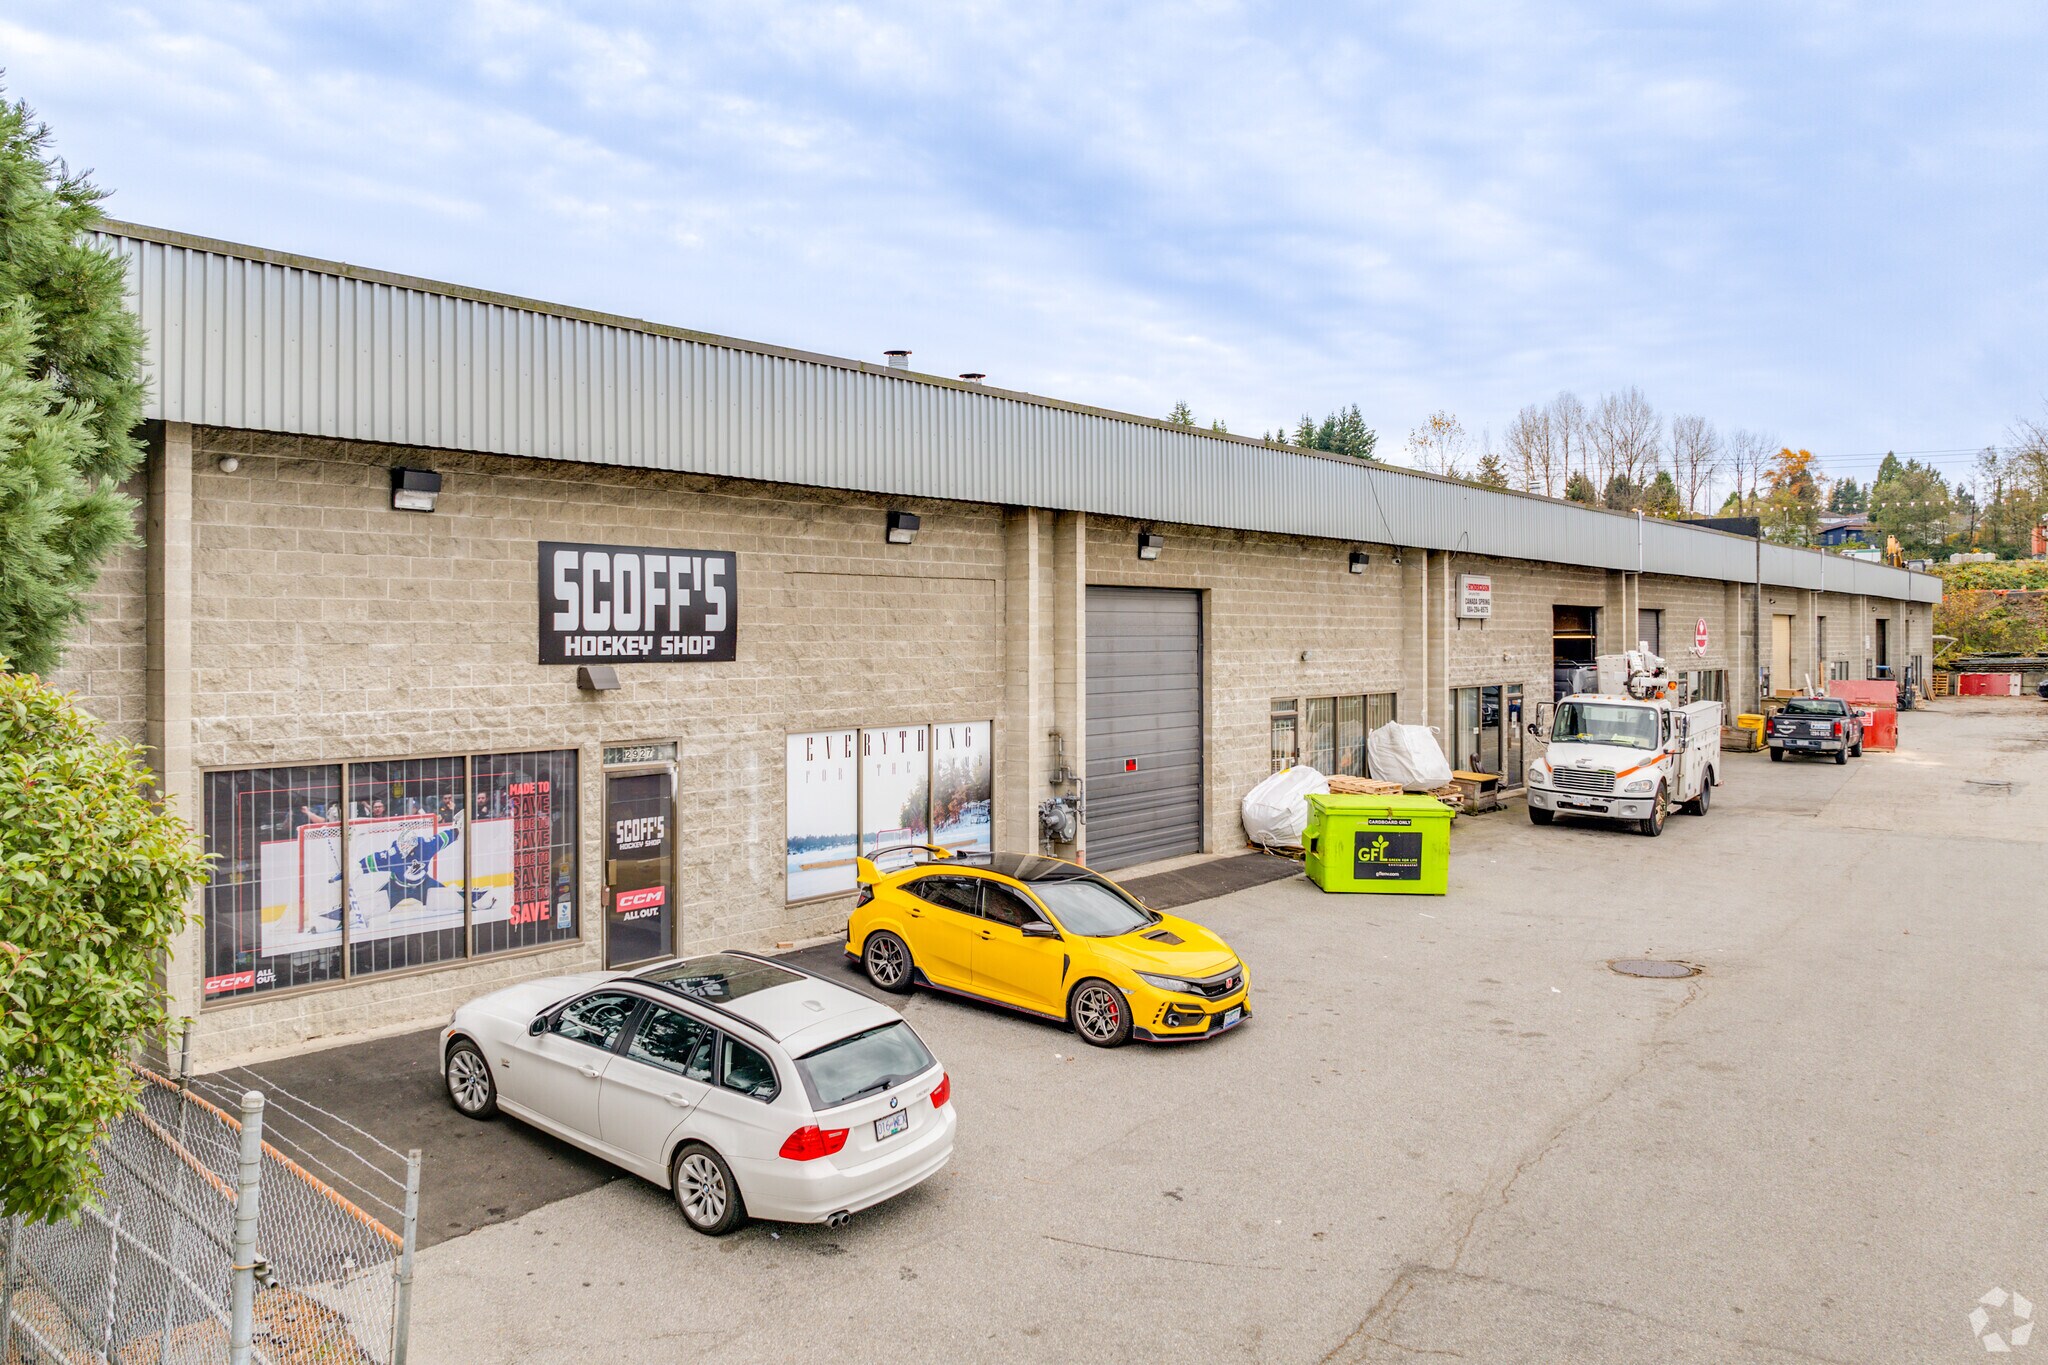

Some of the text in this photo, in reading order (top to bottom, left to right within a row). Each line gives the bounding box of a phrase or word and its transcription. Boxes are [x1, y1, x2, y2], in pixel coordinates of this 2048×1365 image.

[553, 550, 727, 632] SCOFF'S
[565, 636, 715, 656] HOCKEY SHOP
[806, 726, 971, 762] EVERYTHING
[876, 761, 911, 777] THE
[509, 781, 550, 795] MADE TO
[510, 795, 550, 817] SAVE
[616, 815, 664, 844] SCOFF'S
[619, 839, 661, 850] HOCKEY SHOP
[1358, 842, 1388, 862] GFL
[510, 865, 550, 888] SAVE
[619, 891, 662, 907] CCM
[510, 901, 550, 925] SAVE
[624, 907, 659, 921] ALL OUT.
[206, 975, 252, 990] CCM
[256, 968, 274, 978] ALL
